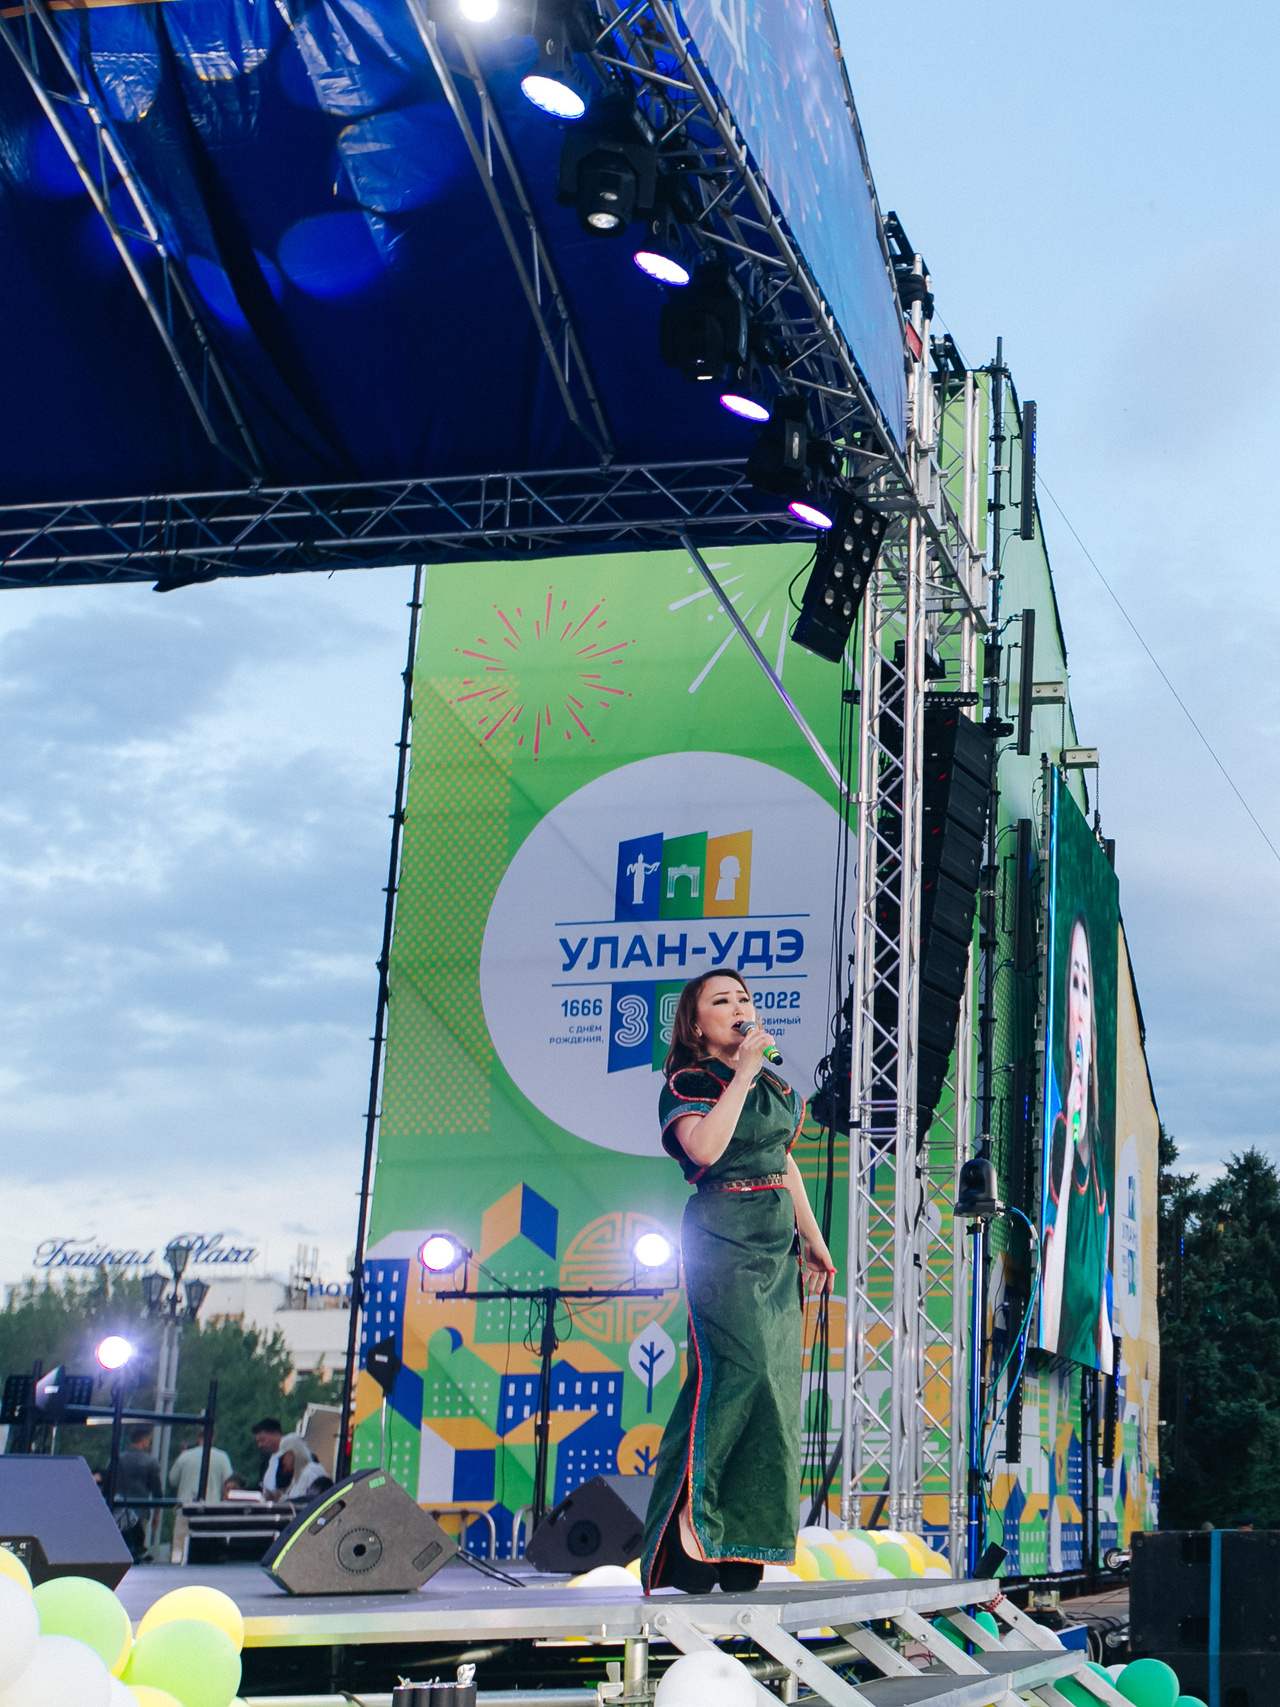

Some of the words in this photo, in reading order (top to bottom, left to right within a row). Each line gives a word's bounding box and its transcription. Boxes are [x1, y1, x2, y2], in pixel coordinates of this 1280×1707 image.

[558, 928, 804, 972] УЛАН-УДЭ
[561, 998, 603, 1018] 1666
[753, 990, 801, 1010] 2022
[568, 1025, 575, 1034] С
[576, 1023, 603, 1034] ДНЁМ
